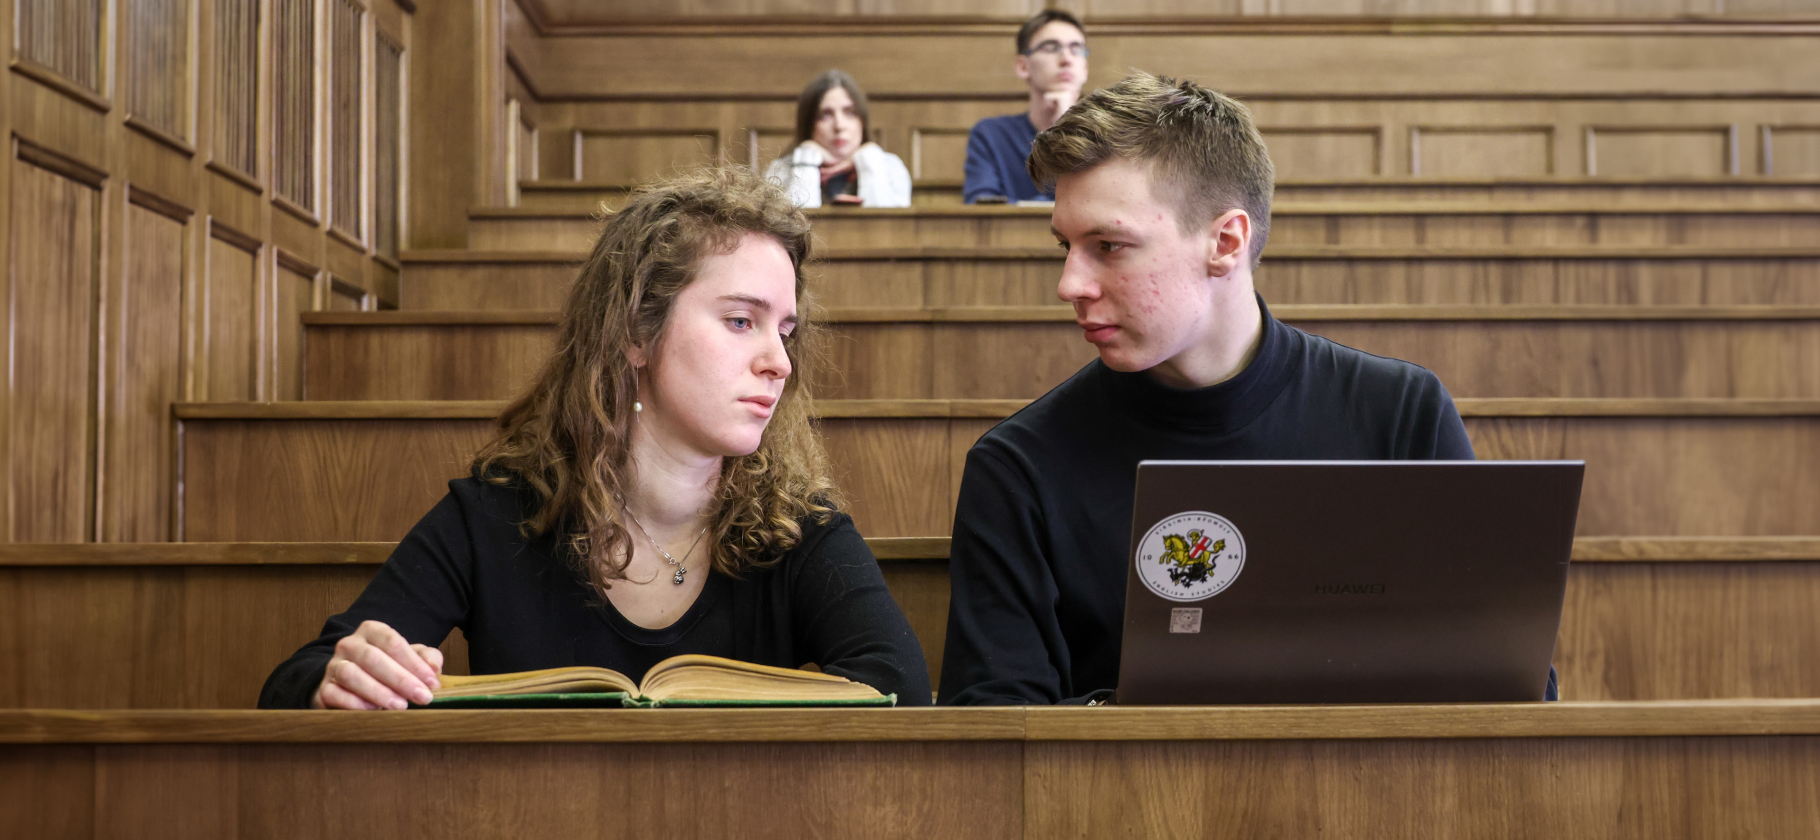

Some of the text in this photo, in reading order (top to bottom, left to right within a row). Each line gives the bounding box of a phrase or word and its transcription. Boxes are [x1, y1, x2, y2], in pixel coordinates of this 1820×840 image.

[1152, 580, 1225, 596] ENGLISH STUDIES
[1315, 584, 1386, 595] HUAWEI
